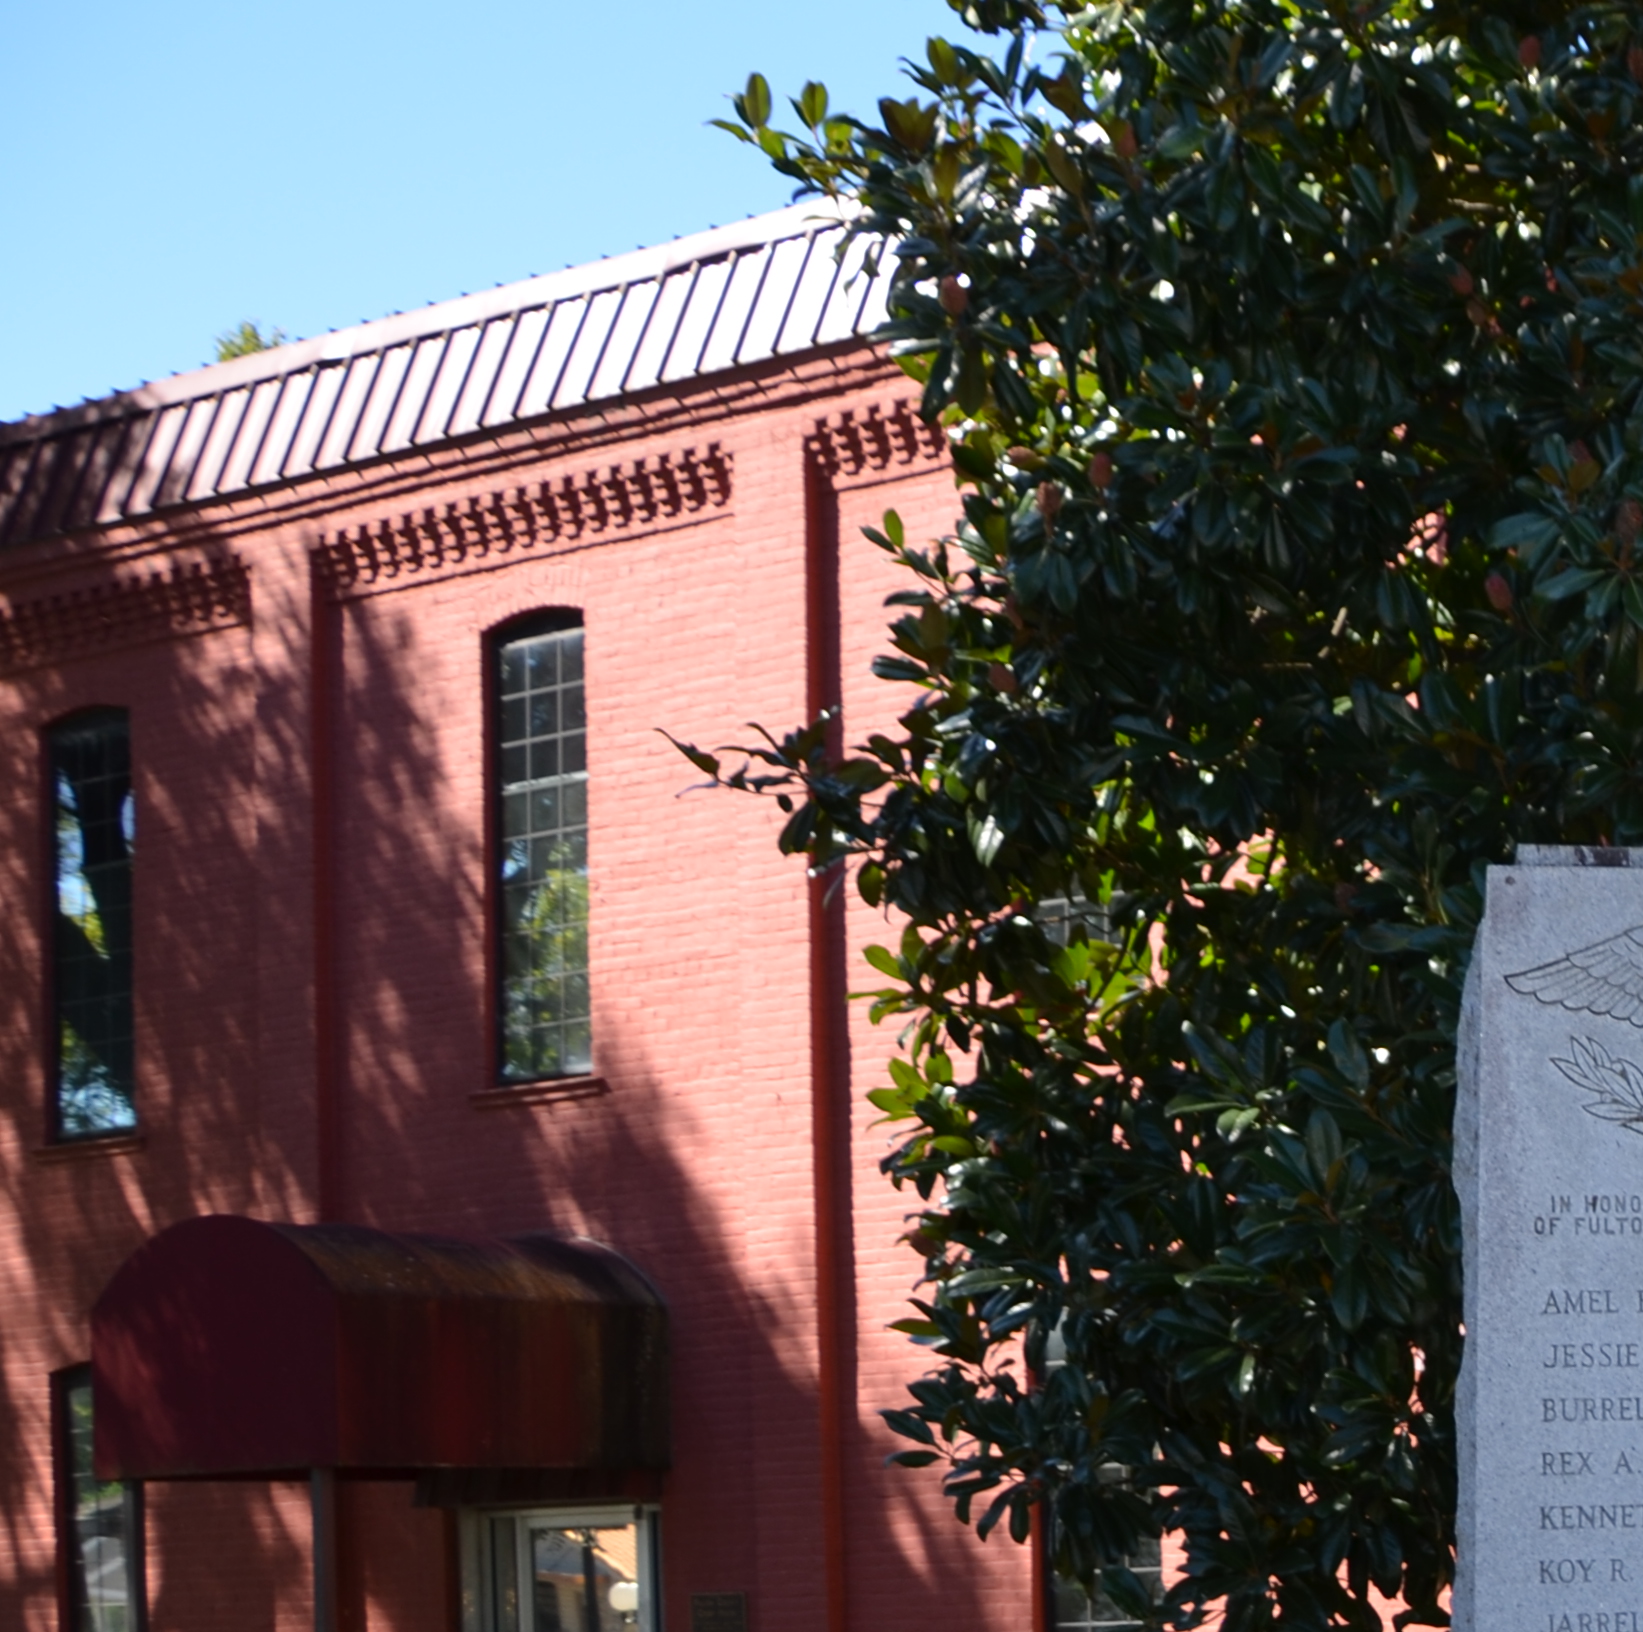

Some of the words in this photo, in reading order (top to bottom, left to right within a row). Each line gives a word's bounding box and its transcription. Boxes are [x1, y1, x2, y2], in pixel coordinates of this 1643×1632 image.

[1550, 1195, 1572, 1214] IN
[1534, 1217, 1562, 1236] OF
[1541, 1292, 1618, 1314] AMEL
[1542, 1344, 1640, 1369] JESSIE
[1541, 1452, 1594, 1476] REX
[1613, 1452, 1642, 1474] A.
[1538, 1559, 1596, 1584] KOY
[1610, 1559, 1633, 1581] R.
